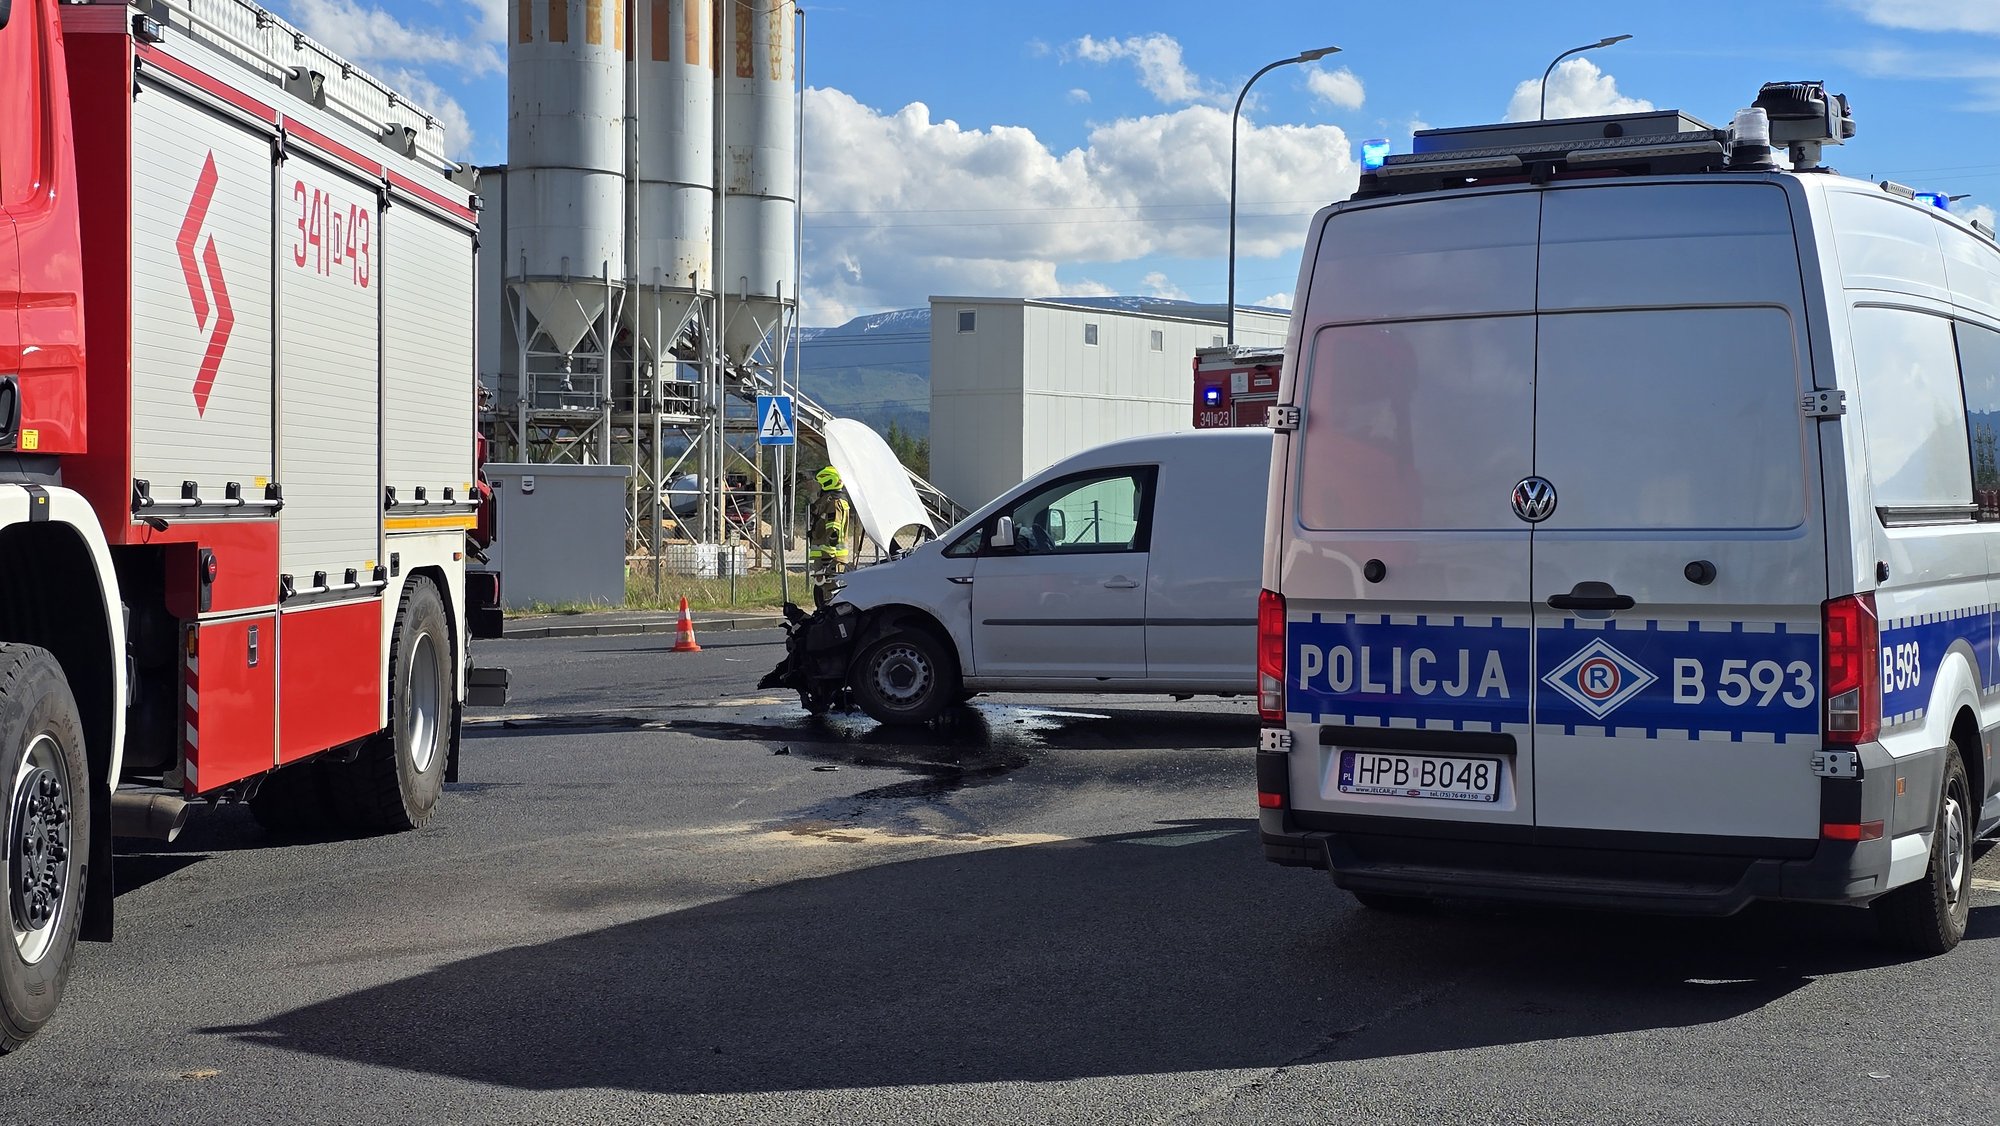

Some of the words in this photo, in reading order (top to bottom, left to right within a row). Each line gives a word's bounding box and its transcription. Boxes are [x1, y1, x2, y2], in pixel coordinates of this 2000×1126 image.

[1299, 644, 1511, 698] POLICJA
[1589, 667, 1609, 689] R
[1673, 658, 1706, 704] B
[1716, 659, 1815, 709] 593
[1883, 646, 1894, 694] B
[1896, 641, 1920, 690] 593
[1343, 772, 1352, 781] PL
[1358, 756, 1409, 786] HPB
[1420, 760, 1489, 791] B048
